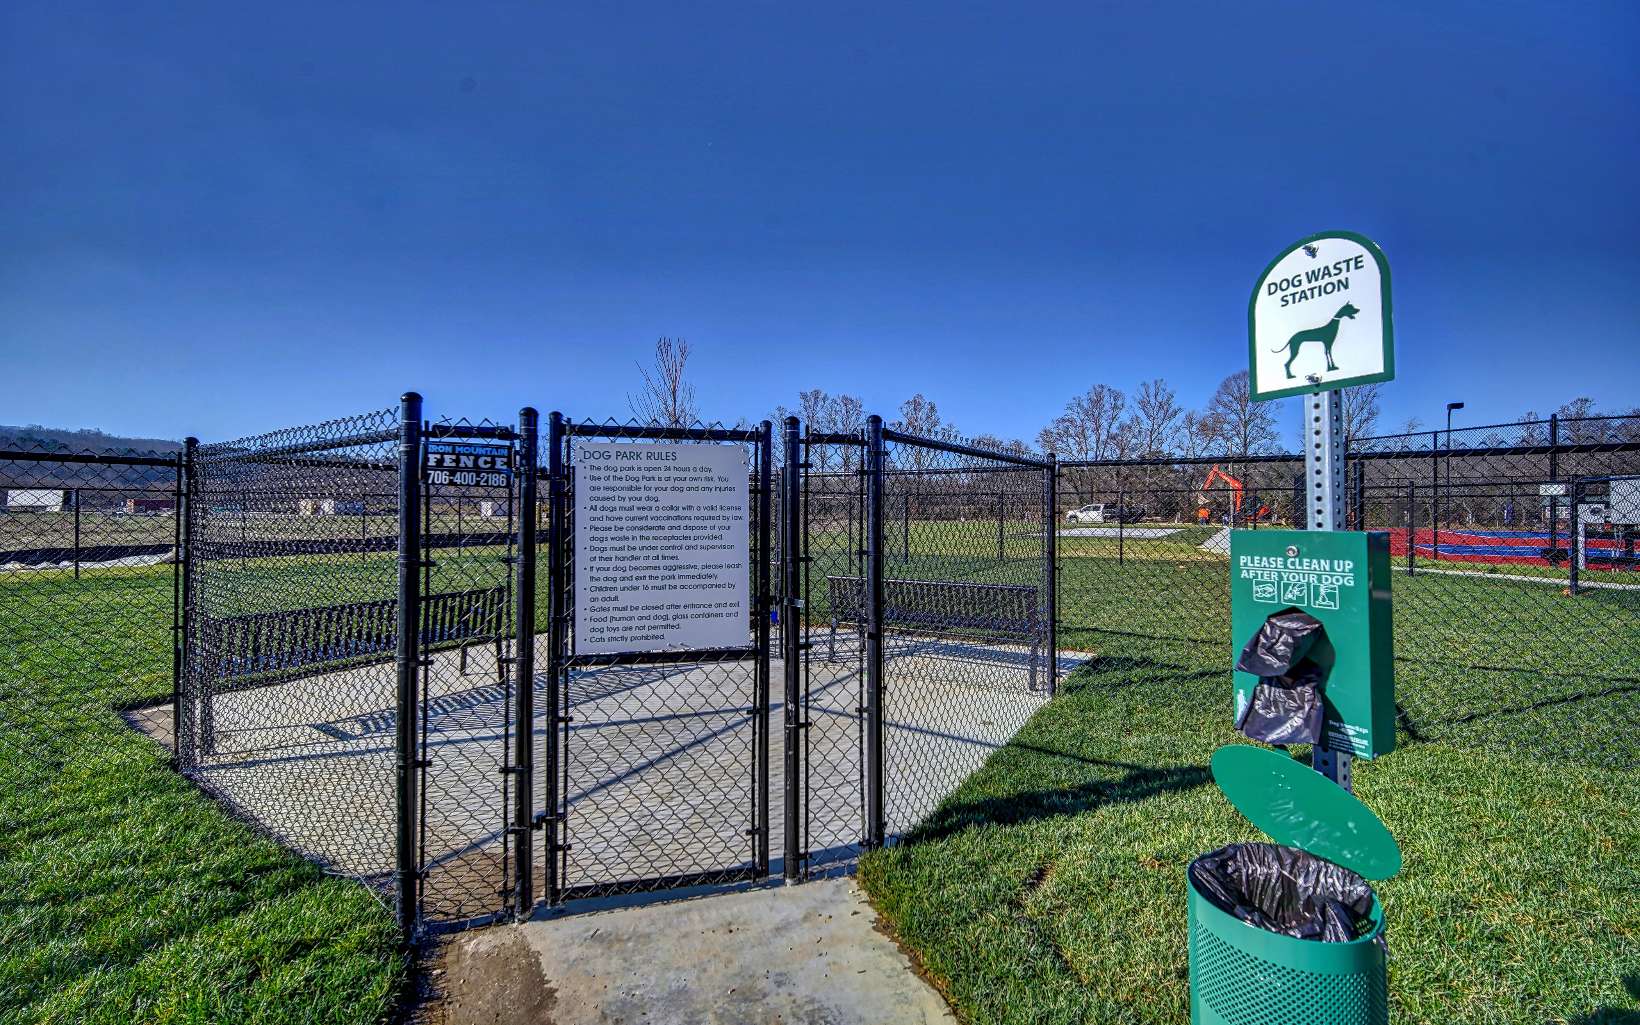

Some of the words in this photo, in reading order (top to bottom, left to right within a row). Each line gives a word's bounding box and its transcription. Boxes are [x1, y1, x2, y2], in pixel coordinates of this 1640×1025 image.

[1267, 274, 1302, 296] DOG
[1305, 254, 1365, 284] WASTE
[1280, 277, 1350, 307] STATION
[428, 444, 452, 454] IRON
[455, 446, 509, 456] MOUNTAIN
[583, 450, 611, 460] DOG
[615, 450, 642, 461] PARK
[646, 451, 677, 461] RULES
[427, 454, 508, 469] FENCE
[603, 464, 618, 473] dog
[620, 465, 636, 473] park
[644, 466, 662, 474] open
[427, 470, 507, 487] 706-400-2186
[625, 475, 639, 483] Dog
[672, 476, 687, 484] your
[603, 485, 642, 493] responsible
[670, 485, 684, 493] dog
[714, 485, 736, 493] injuries
[618, 495, 626, 503] by
[644, 495, 660, 503] dog.
[599, 505, 617, 513] dogs
[693, 514, 720, 522] required
[722, 514, 730, 522] by
[682, 524, 708, 532] dispose
[589, 535, 608, 543] dogs
[652, 534, 692, 543] receptacles
[590, 544, 608, 553] Dogs
[699, 543, 735, 552] supervision
[612, 564, 627, 573] dog
[629, 563, 661, 571] becomes
[701, 562, 724, 571] please
[1240, 556, 1284, 569] PLEASE
[1287, 558, 1331, 571] CLEAN
[1334, 560, 1354, 572] UP
[603, 574, 617, 583] dog
[661, 573, 676, 582] park
[1240, 570, 1279, 580] AFTER
[1281, 572, 1317, 584] YOUR
[1322, 576, 1354, 586] DOG
[651, 583, 667, 591] must
[679, 582, 726, 592] accompanied
[727, 582, 735, 590] by
[612, 604, 628, 612] must
[641, 603, 664, 611] closed
[672, 612, 689, 621] glass
[690, 611, 724, 619] containers
[725, 610, 739, 618] and
[589, 625, 604, 634] dog
[606, 625, 620, 634] toys
[589, 635, 605, 643] Cats
[607, 634, 628, 644] strictly
